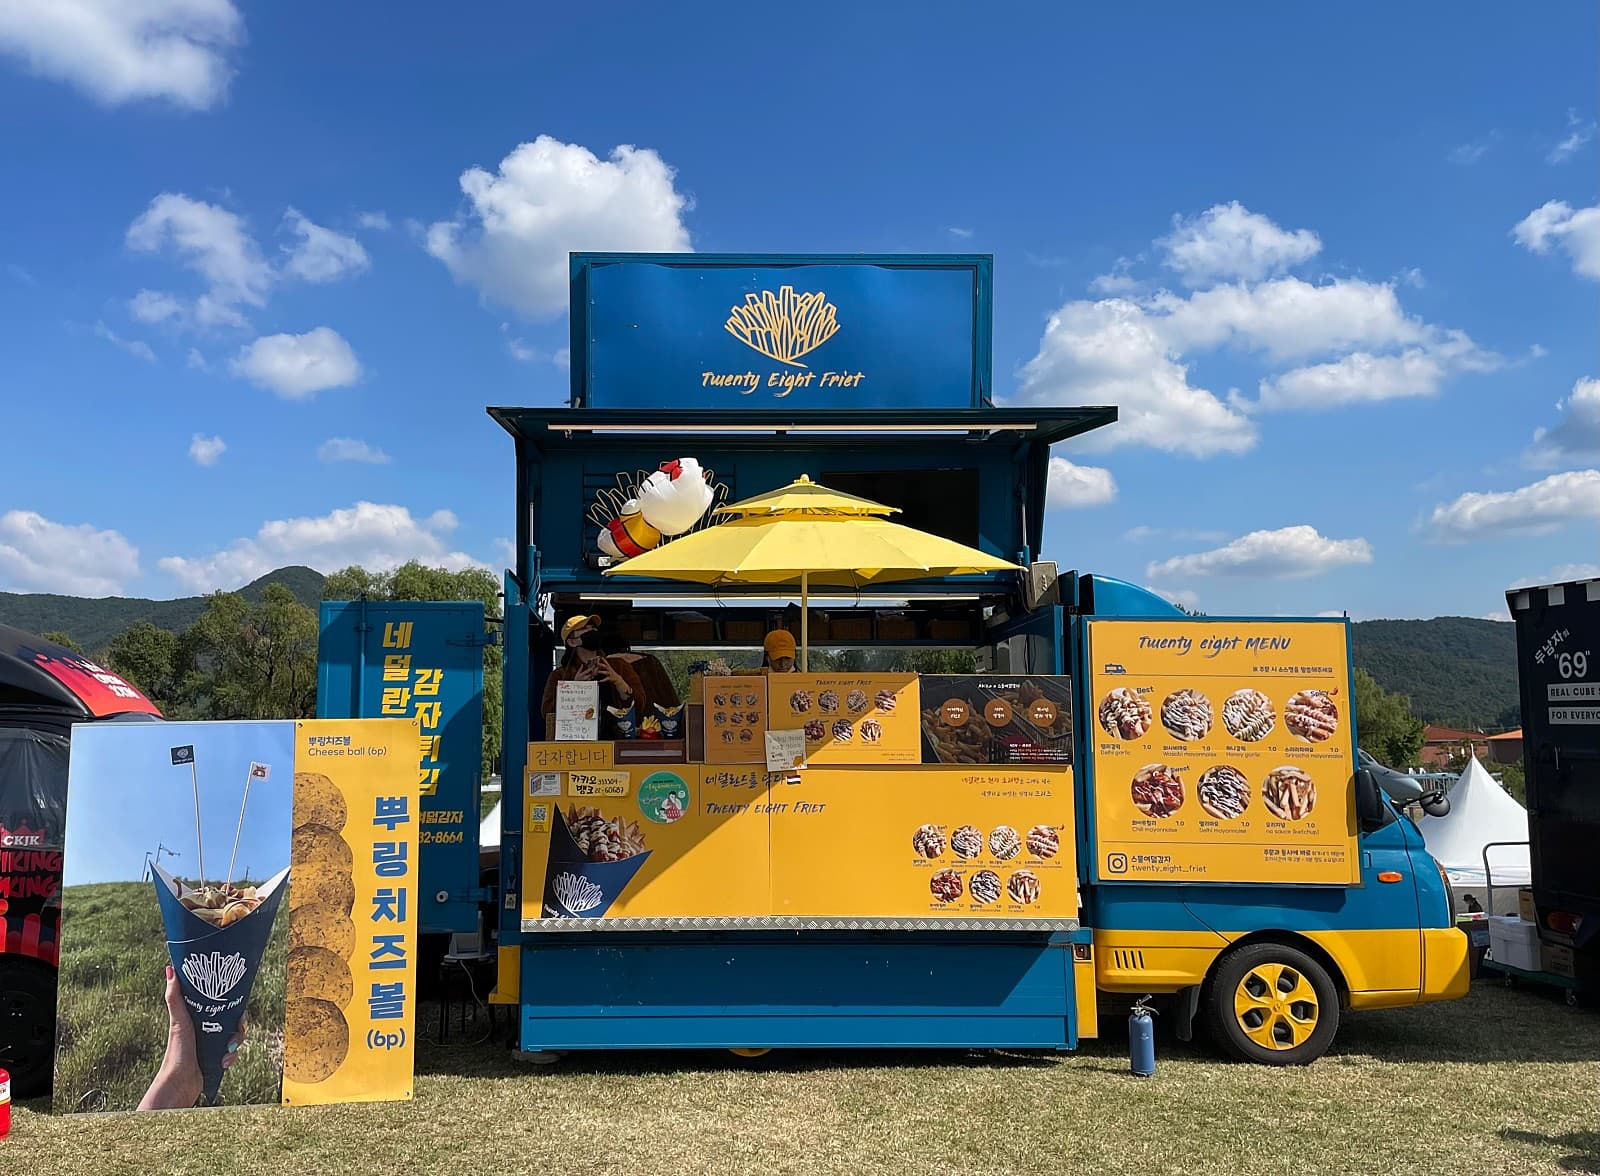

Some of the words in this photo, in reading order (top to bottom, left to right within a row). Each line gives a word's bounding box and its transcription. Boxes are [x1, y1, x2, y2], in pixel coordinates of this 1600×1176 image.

[701, 371, 761, 396] Twenty
[768, 371, 817, 398] Eight
[819, 371, 866, 388] Friet
[1139, 635, 1193, 656] Twenty
[1199, 635, 1242, 658] eight
[1245, 637, 1292, 656] MENU
[382, 622, 413, 716] 네덜란
[1136, 686, 1154, 694] Best
[1550, 688, 1570, 697] REAL
[1573, 687, 1595, 696] CUBE
[1551, 711, 1568, 720] FOR
[309, 735, 351, 747] 뿌링치즈볼
[308, 747, 345, 756] Cheese
[347, 747, 365, 756] ball
[367, 746, 387, 757] (6p)
[536, 749, 608, 766] 감자합니다
[570, 773, 597, 785] 카카오
[576, 785, 594, 795] 뱅크
[706, 802, 750, 814] TWENTY
[754, 803, 789, 814] EIGHT
[793, 800, 827, 815] FRIET
[368, 796, 410, 1020] 뿌링치즈볼
[367, 1028, 406, 1052] (6p)
